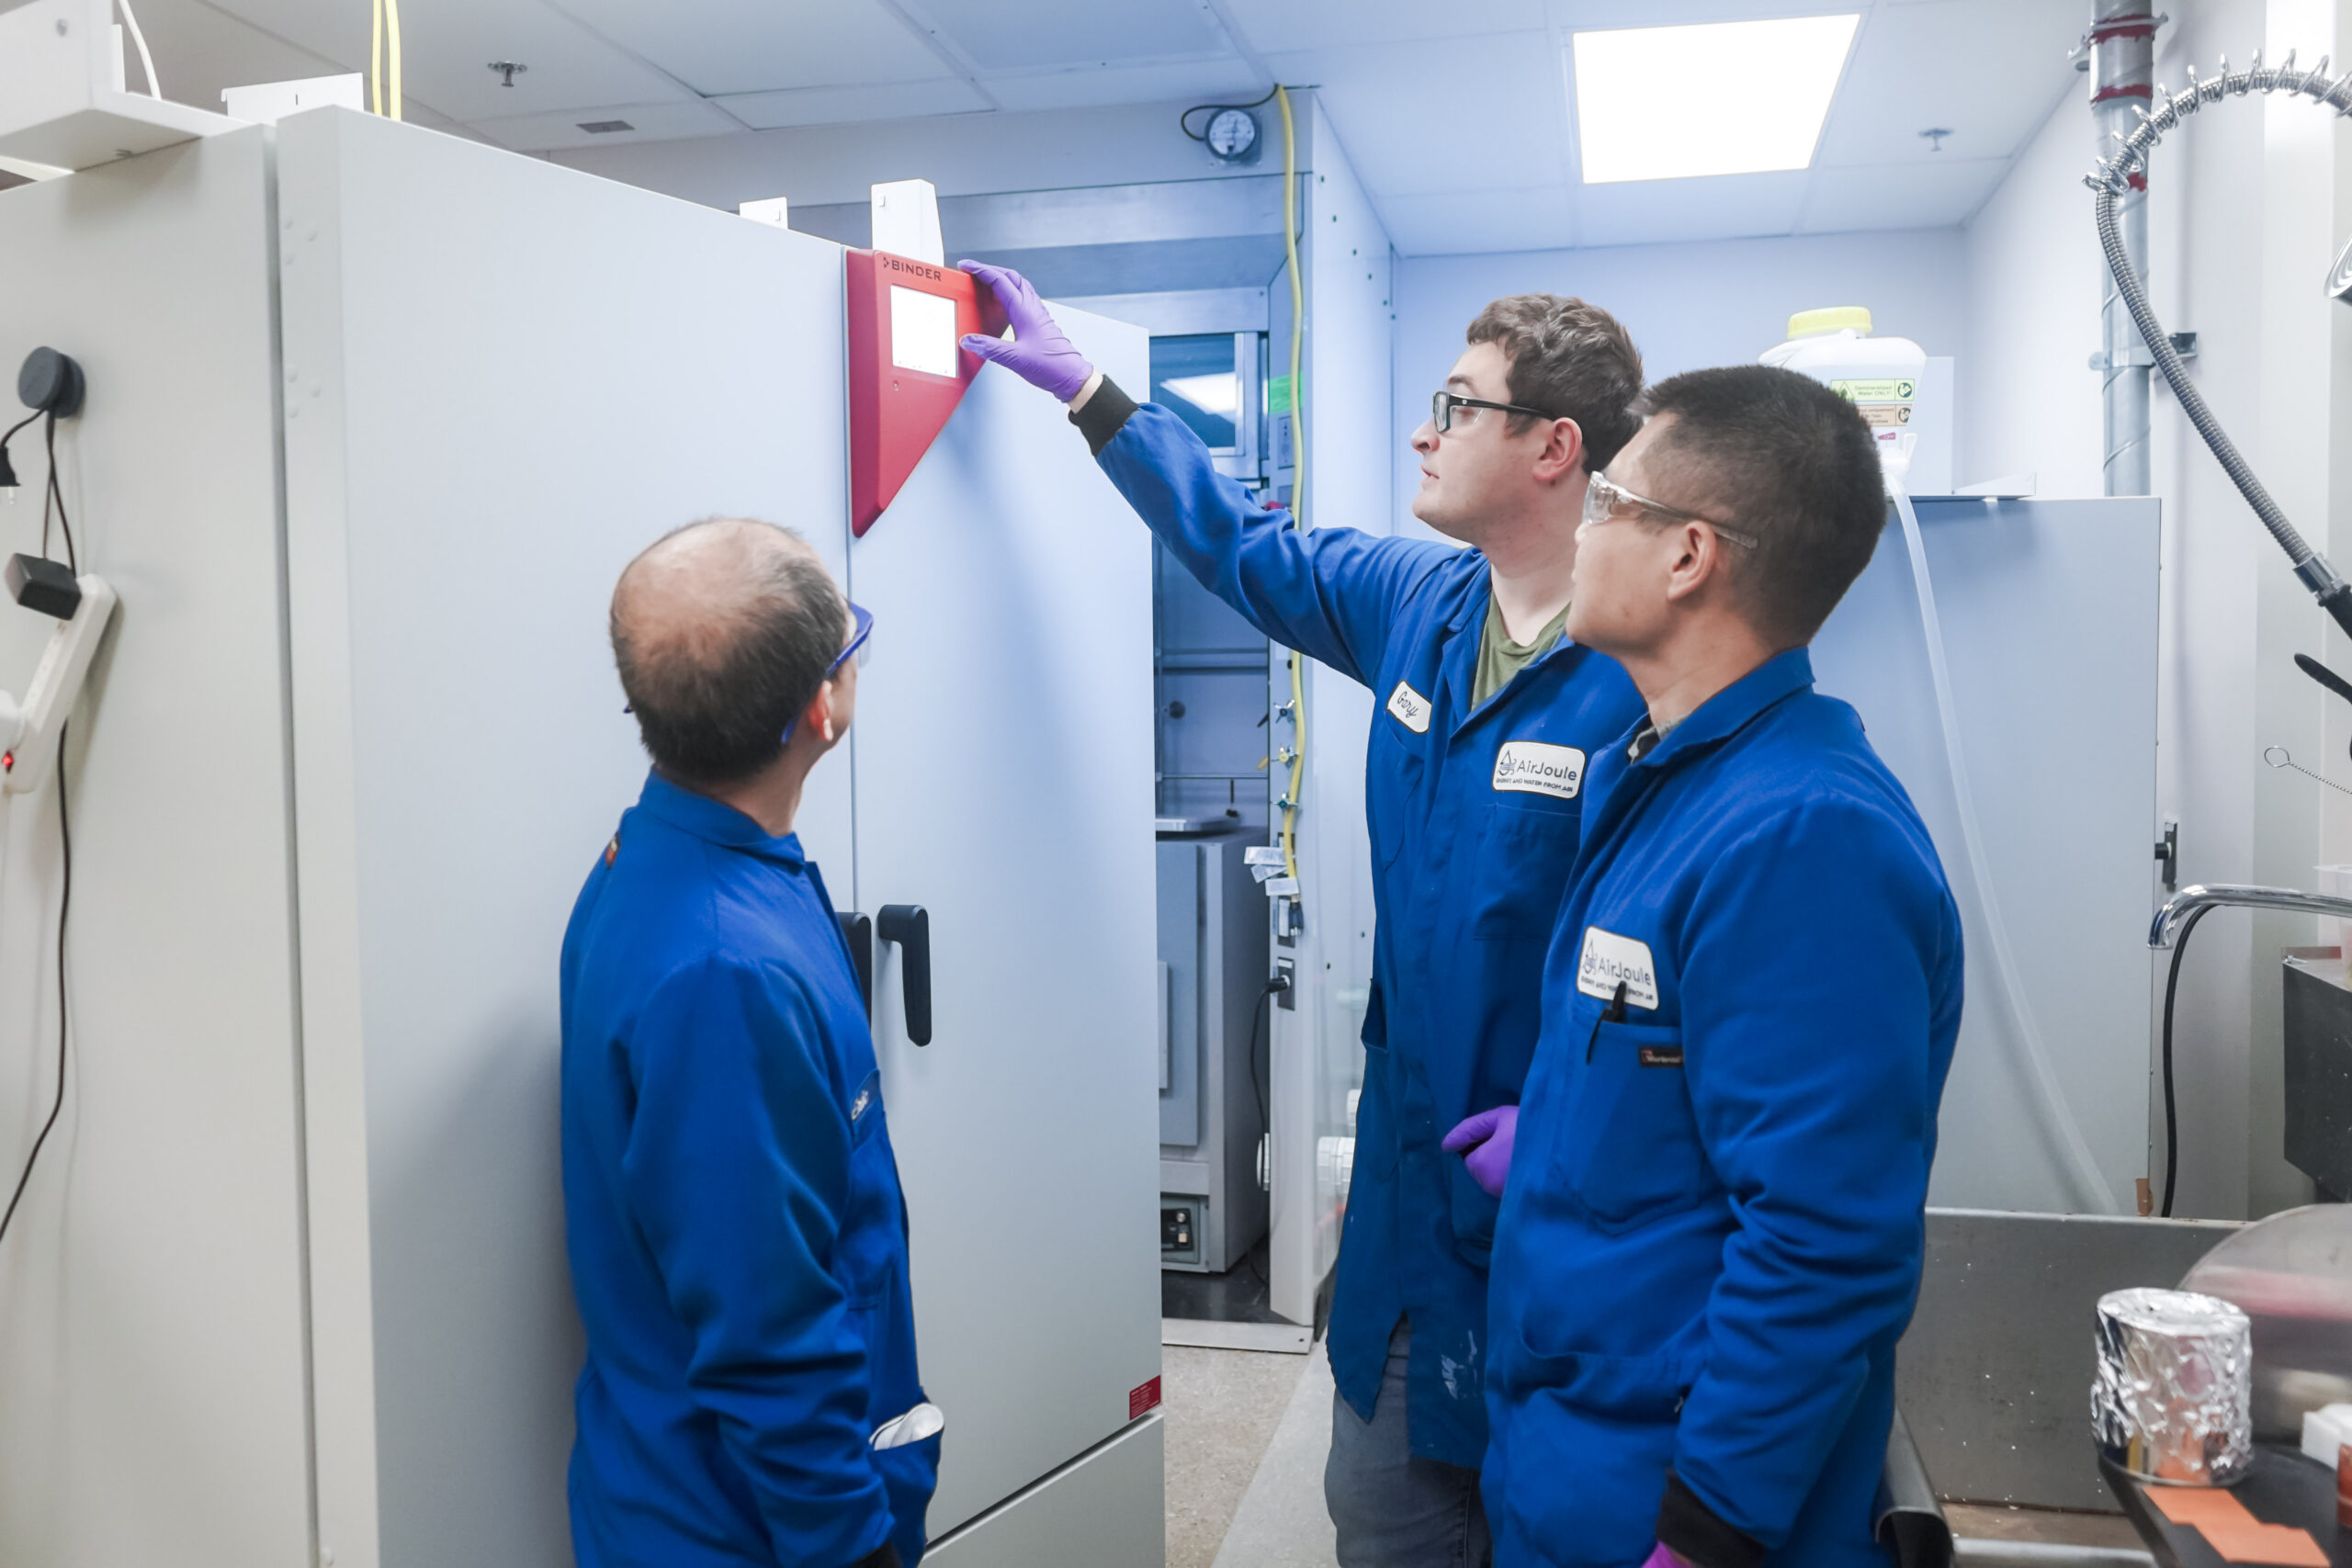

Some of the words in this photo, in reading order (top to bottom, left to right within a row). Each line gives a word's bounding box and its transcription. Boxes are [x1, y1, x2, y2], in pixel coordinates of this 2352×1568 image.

[891, 259, 942, 282] BINDER
[1516, 760, 1577, 781] AirJoule
[1524, 778, 1543, 786] WATER
[1599, 957, 1652, 987] AirJoule
